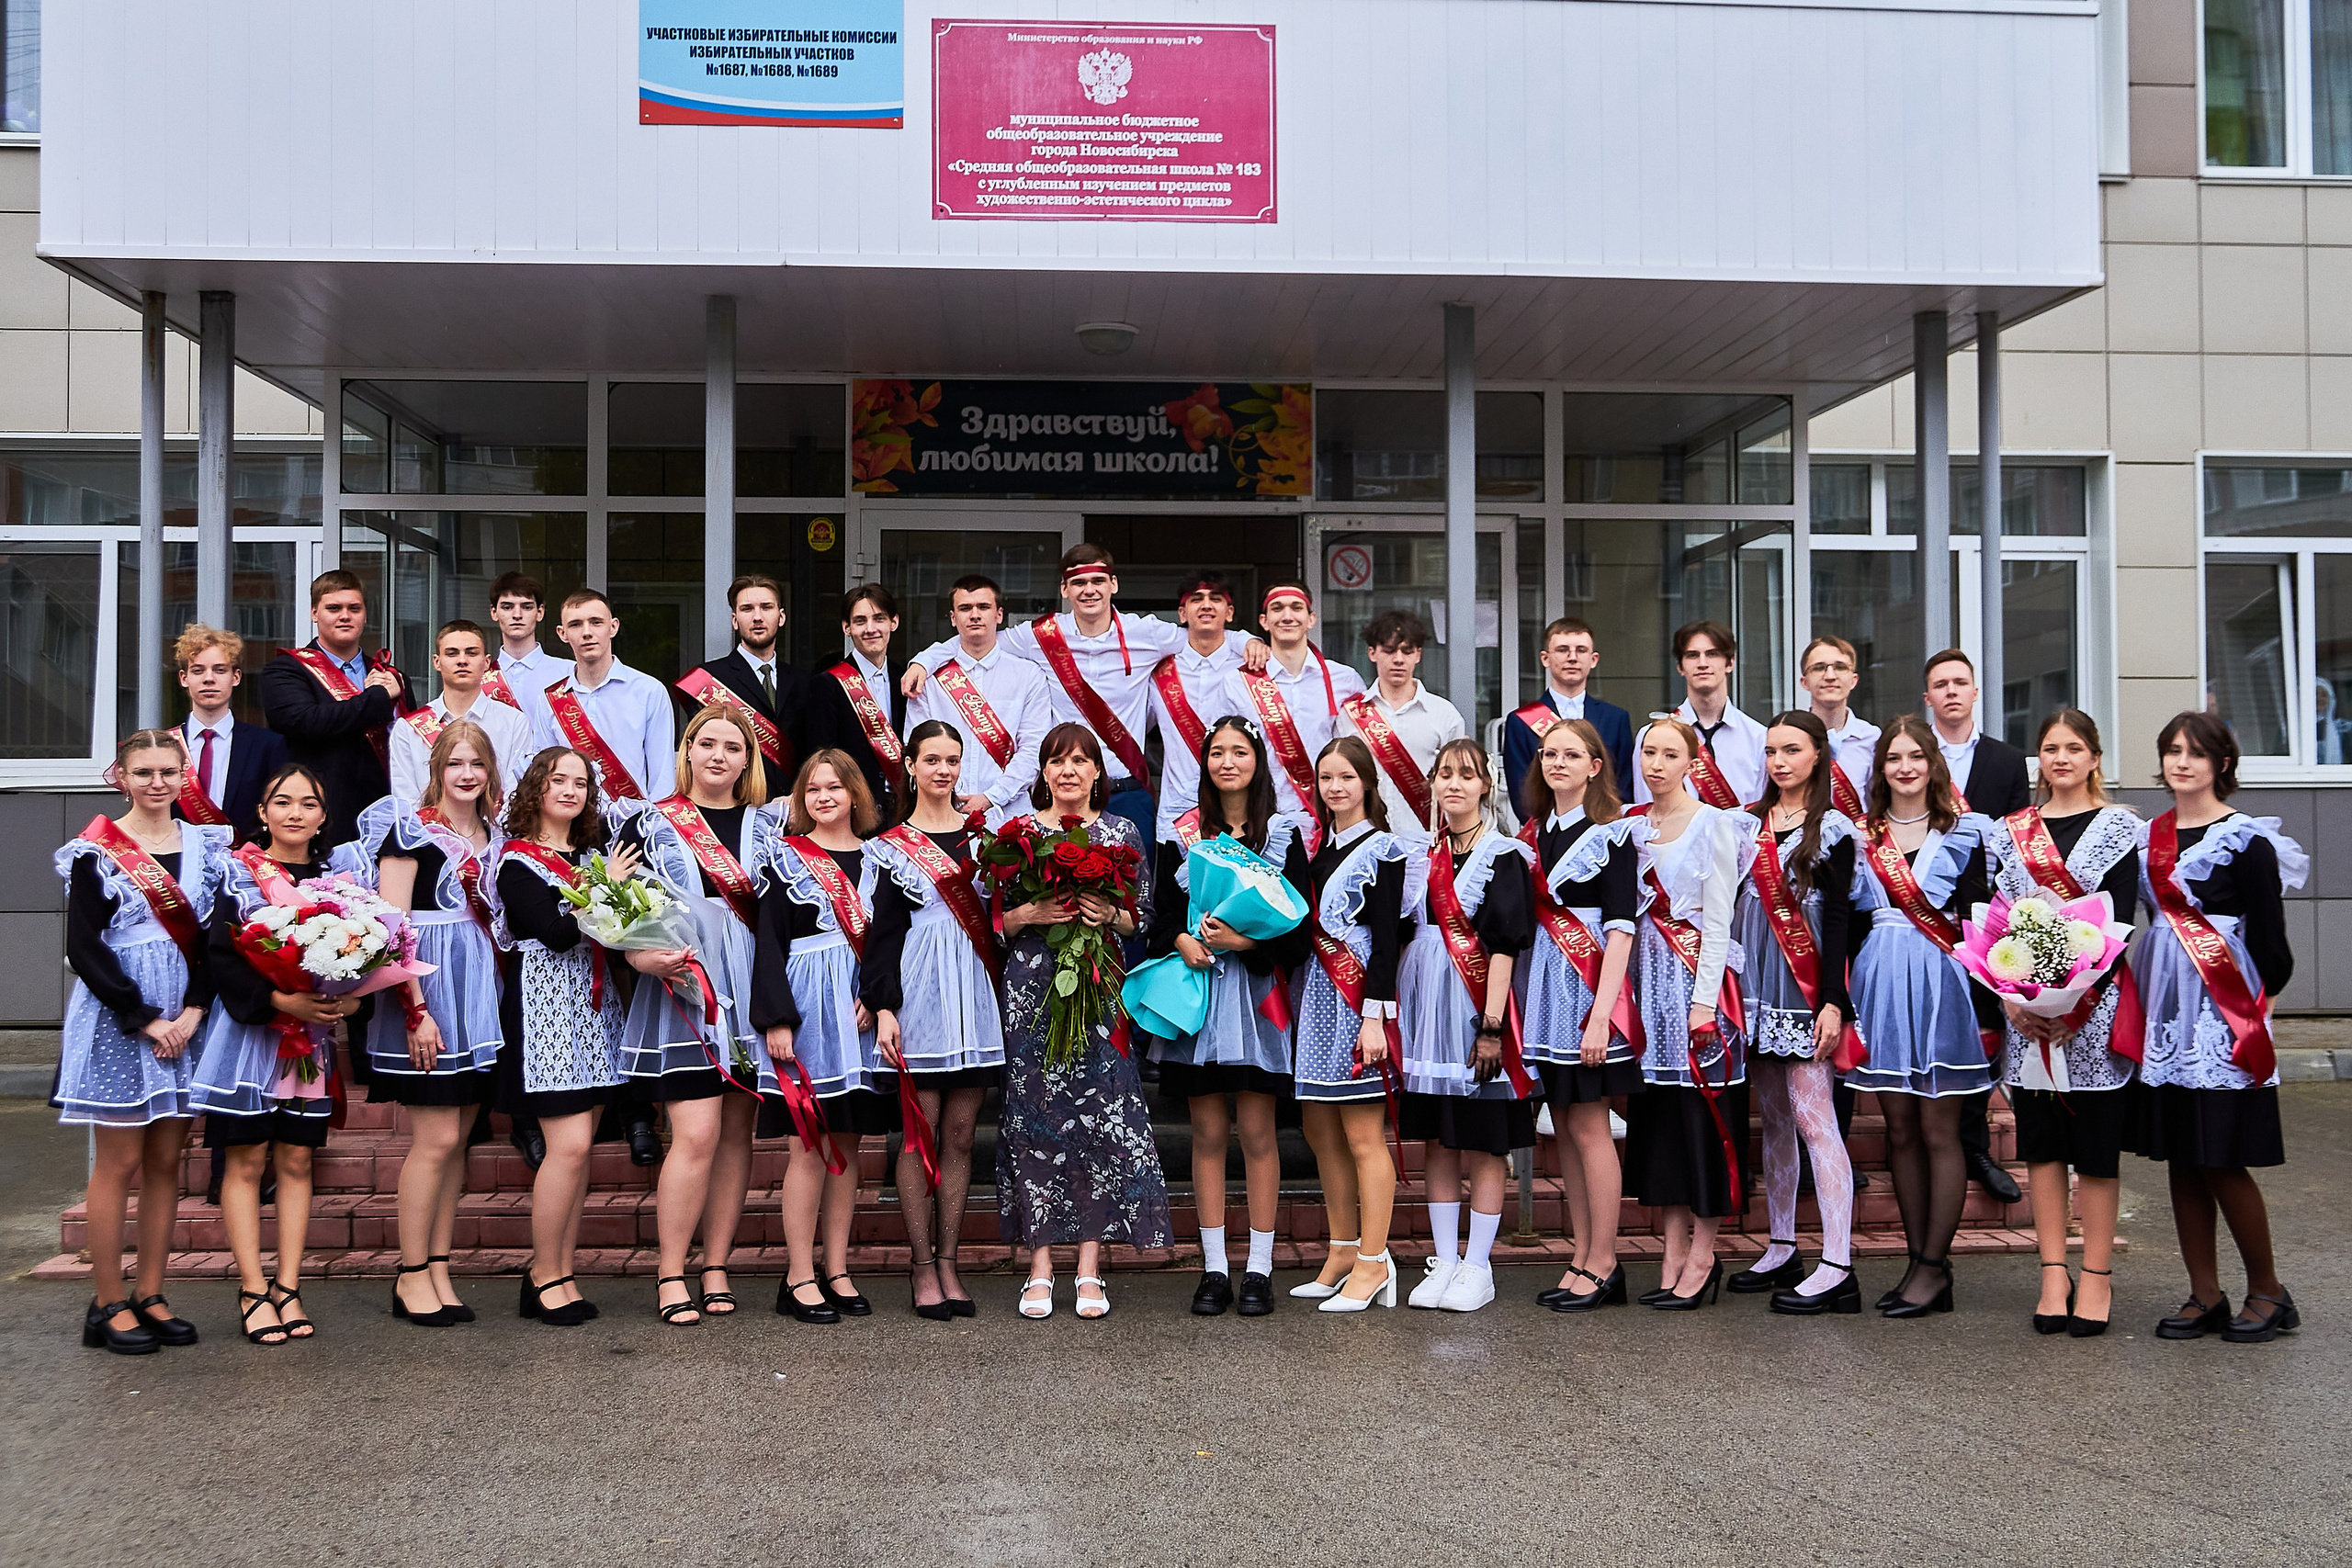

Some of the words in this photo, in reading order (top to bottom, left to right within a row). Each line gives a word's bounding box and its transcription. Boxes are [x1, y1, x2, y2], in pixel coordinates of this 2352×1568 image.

[646, 28, 726, 41] УЧАСТКОВЫЕ
[729, 28, 830, 43] ИЗБИРАТЕЛЬНЫЕ
[831, 30, 898, 44] КОМИССИИ
[1007, 32, 1080, 44] Министерство
[1080, 34, 1146, 45] образования
[1156, 37, 1186, 46] науки
[1187, 36, 1204, 45] РФ
[689, 46, 792, 60] ИЗБИРАТЕЛЬНЫХ
[794, 47, 854, 61] УЧАСТКОВ
[706, 63, 749, 78] №1687,
[750, 64, 795, 79] №1688,
[797, 65, 839, 78] №1689
[1010, 114, 1120, 128] муниципальное
[1121, 113, 1200, 128] бюджетное
[986, 127, 1138, 142] общеобразовательное
[1139, 131, 1224, 144] учреждение
[1031, 145, 1078, 158] города
[1080, 142, 1179, 160] Новосибирска
[947, 159, 1013, 175] «Средняя
[1015, 160, 1168, 176] общеобразовательная
[1170, 164, 1215, 175] школа
[1216, 163, 1233, 175] №
[1235, 163, 1261, 176] 183
[977, 178, 987, 189] с
[988, 176, 1080, 192] углубленным
[1082, 179, 1157, 192] изучением
[1159, 181, 1232, 194] предметов
[976, 194, 1182, 208] художественно-эстетического
[1182, 196, 1233, 209] цикла»
[960, 405, 1178, 443] Здравствуй,
[919, 445, 1085, 473] любимая
[1093, 446, 1220, 474] школа!
[1561, 925, 1598, 958] 2025
[1782, 922, 1815, 956] 2025
[2191, 932, 2230, 967] 2025
[1332, 952, 1363, 985] 2025
[1461, 949, 1487, 984] 2025
